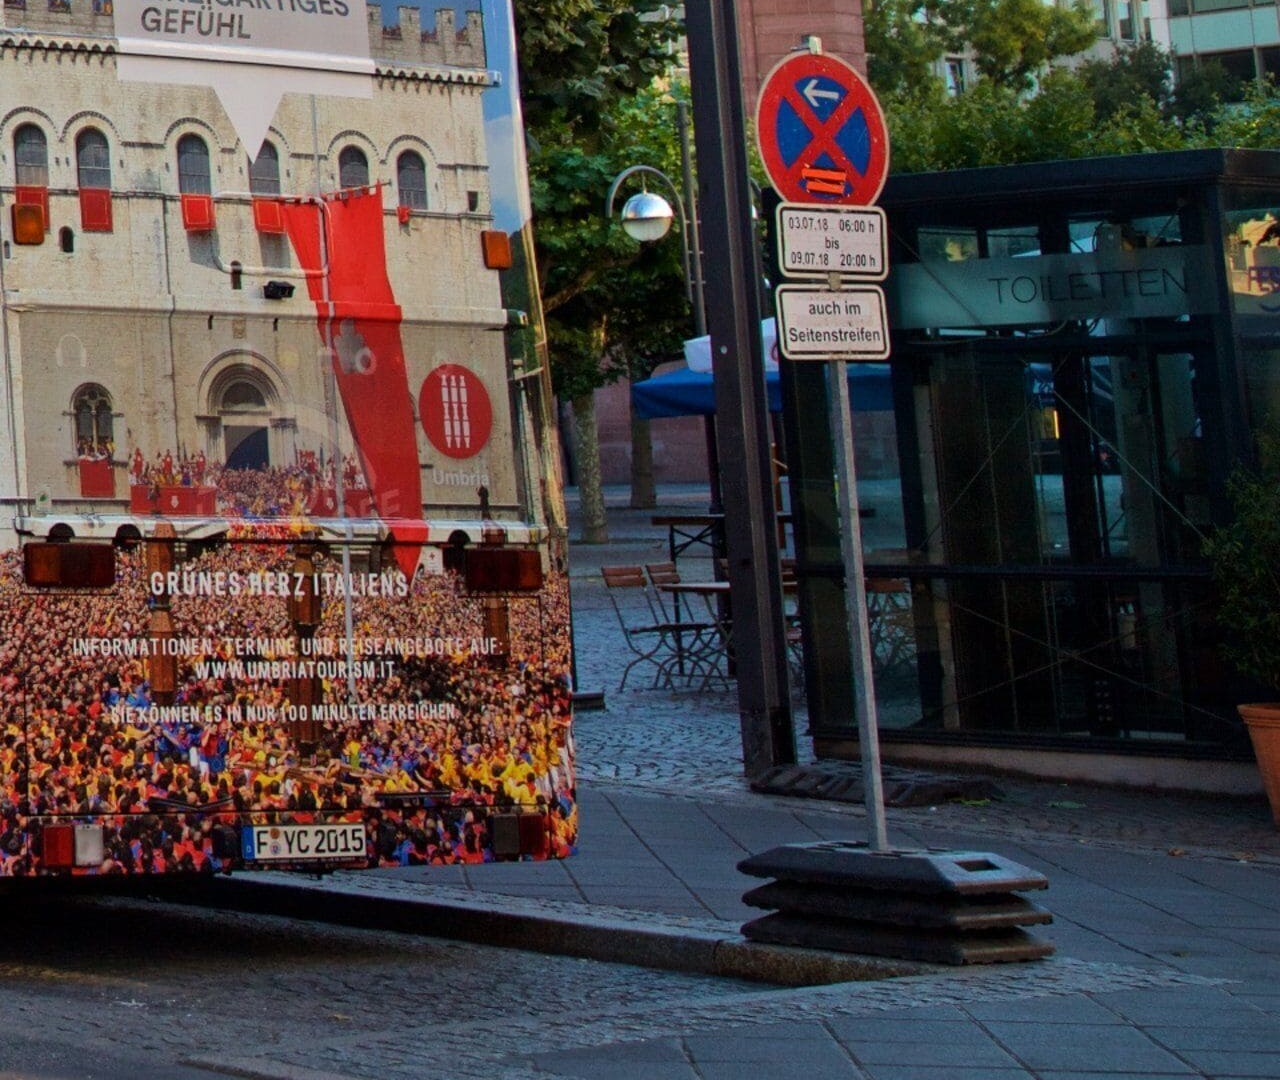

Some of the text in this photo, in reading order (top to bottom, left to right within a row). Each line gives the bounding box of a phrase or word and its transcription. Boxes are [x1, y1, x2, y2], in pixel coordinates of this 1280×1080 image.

[141, 5, 252, 40] GEFÜHL
[788, 217, 875, 233] 03.07.18 06:00 h
[824, 237, 840, 250] bis
[790, 252, 876, 267] 09.07.18 20:00 h
[988, 267, 1188, 305] TOILETTEN
[808, 301, 861, 316] auch im
[789, 327, 881, 343] Seitenstreifen
[432, 467, 490, 487] Umbria
[150, 565, 408, 596] GRÜNES HERZ ITALIENS
[225, 637, 296, 656] TERMINE
[301, 637, 333, 655] UND
[341, 637, 464, 656] REISEANGEBOTE
[470, 637, 504, 655] AUF:
[194, 660, 395, 679] WWW.UMBRIATOURISM.IT
[110, 705, 135, 724] SIE
[139, 703, 200, 723] KÖNNEN
[205, 705, 223, 723] ES
[227, 705, 240, 722] IN
[246, 705, 276, 722] NUR
[281, 705, 308, 721] 100
[312, 704, 376, 721] MINUTEN
[257, 828, 364, 854] F YC 2015
